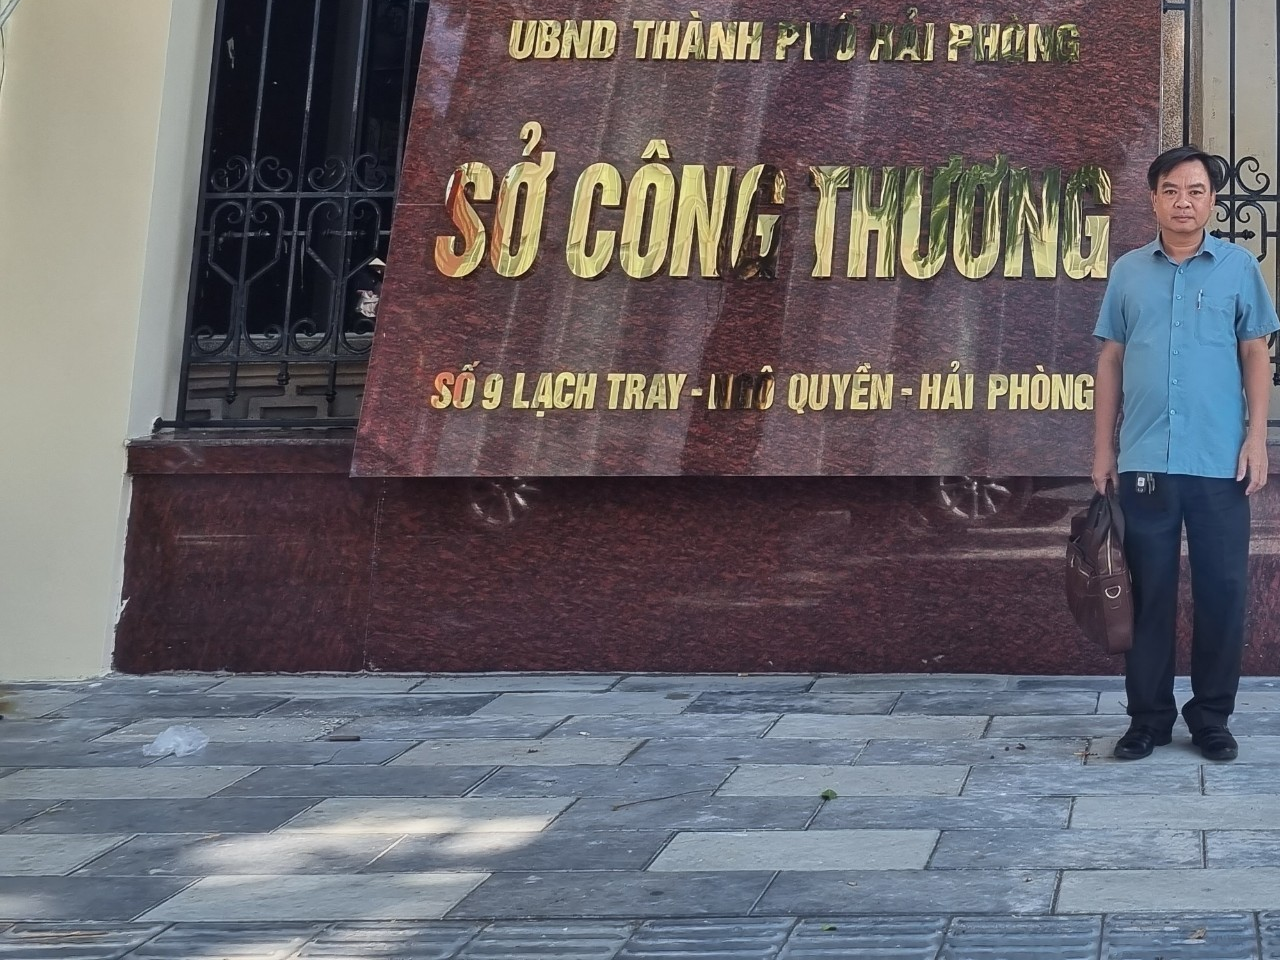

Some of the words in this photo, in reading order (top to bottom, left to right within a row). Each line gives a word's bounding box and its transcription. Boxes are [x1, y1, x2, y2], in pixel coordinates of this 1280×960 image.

[508, 20, 617, 60] UBND
[632, 10, 764, 60] THÀNH
[869, 7, 935, 62] HẢI
[947, 13, 1080, 62] PHÒNG
[434, 121, 556, 279] SỞ
[565, 139, 788, 280] CÔNG
[809, 153, 1112, 280] THƯƠNG
[430, 360, 480, 410] SỐ
[481, 373, 504, 410] 9
[512, 371, 598, 417] LẠCH
[606, 372, 687, 410] TRAY
[787, 362, 894, 414] QUYỀN
[918, 360, 974, 411] HẢI
[987, 365, 1094, 411] PHÒNG
